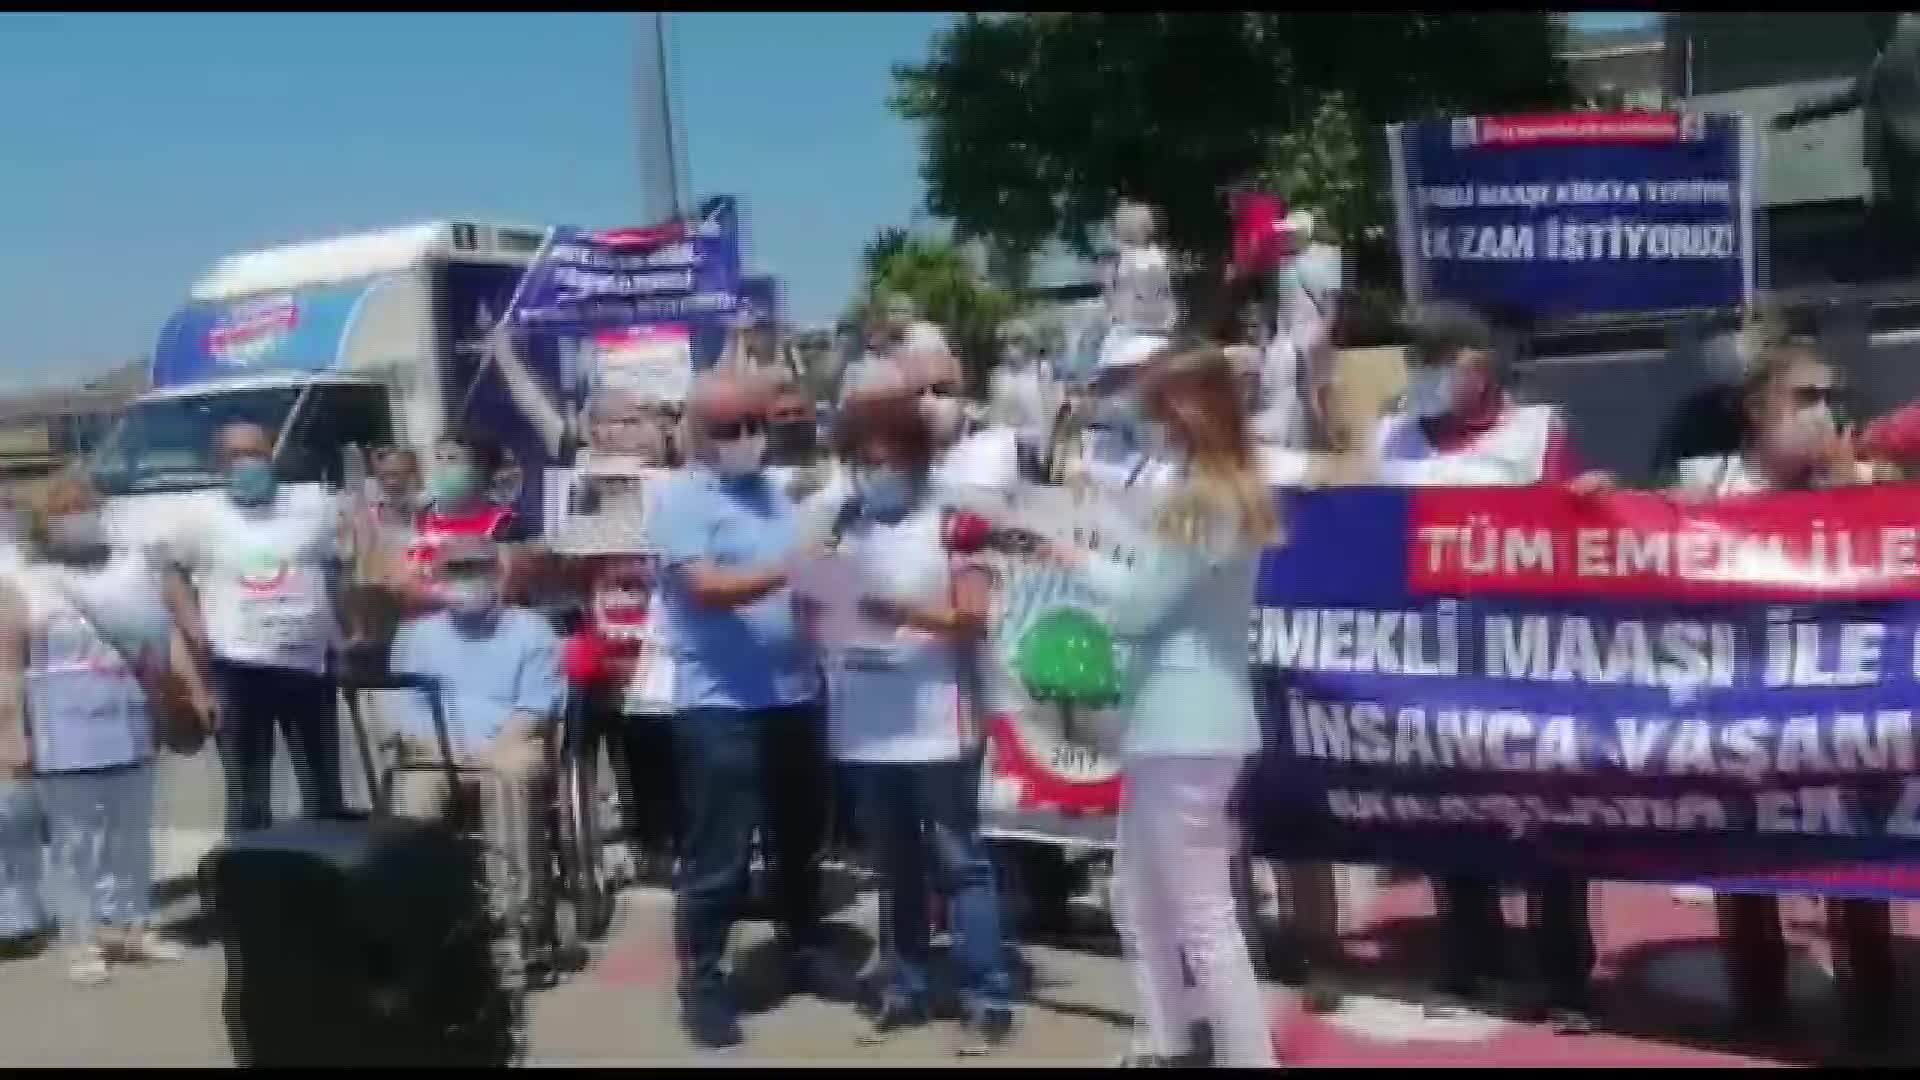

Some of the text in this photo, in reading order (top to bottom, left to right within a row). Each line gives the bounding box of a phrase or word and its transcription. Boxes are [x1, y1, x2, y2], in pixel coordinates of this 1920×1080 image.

[1456, 225, 1535, 259] ZAM
[1418, 514, 1920, 586] TÜM EMEİLE
[1484, 614, 1735, 708] MAAŞI
[1763, 606, 1886, 688] İLE
[1286, 688, 1580, 774] İNSANCA
